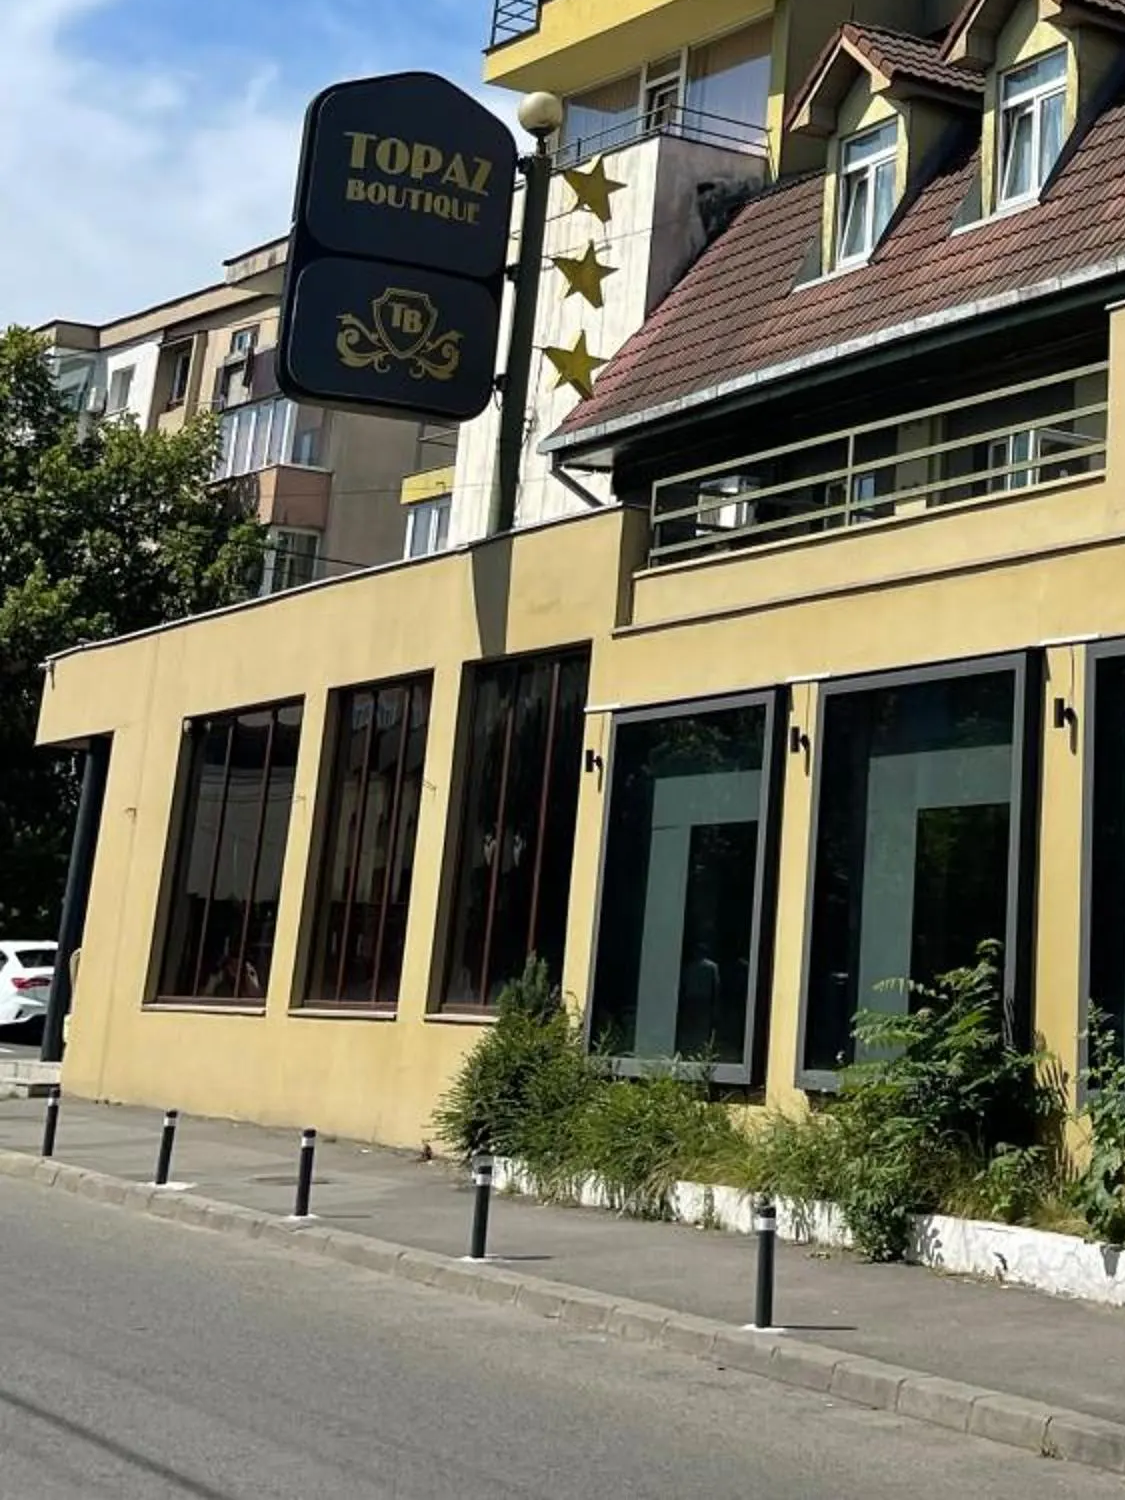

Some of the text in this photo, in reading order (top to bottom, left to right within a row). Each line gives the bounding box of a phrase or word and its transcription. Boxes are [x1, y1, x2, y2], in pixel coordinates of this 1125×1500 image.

[345, 132, 492, 196] TOPAZ
[346, 180, 481, 224] BOUTIQUE
[388, 302, 424, 333] TB
